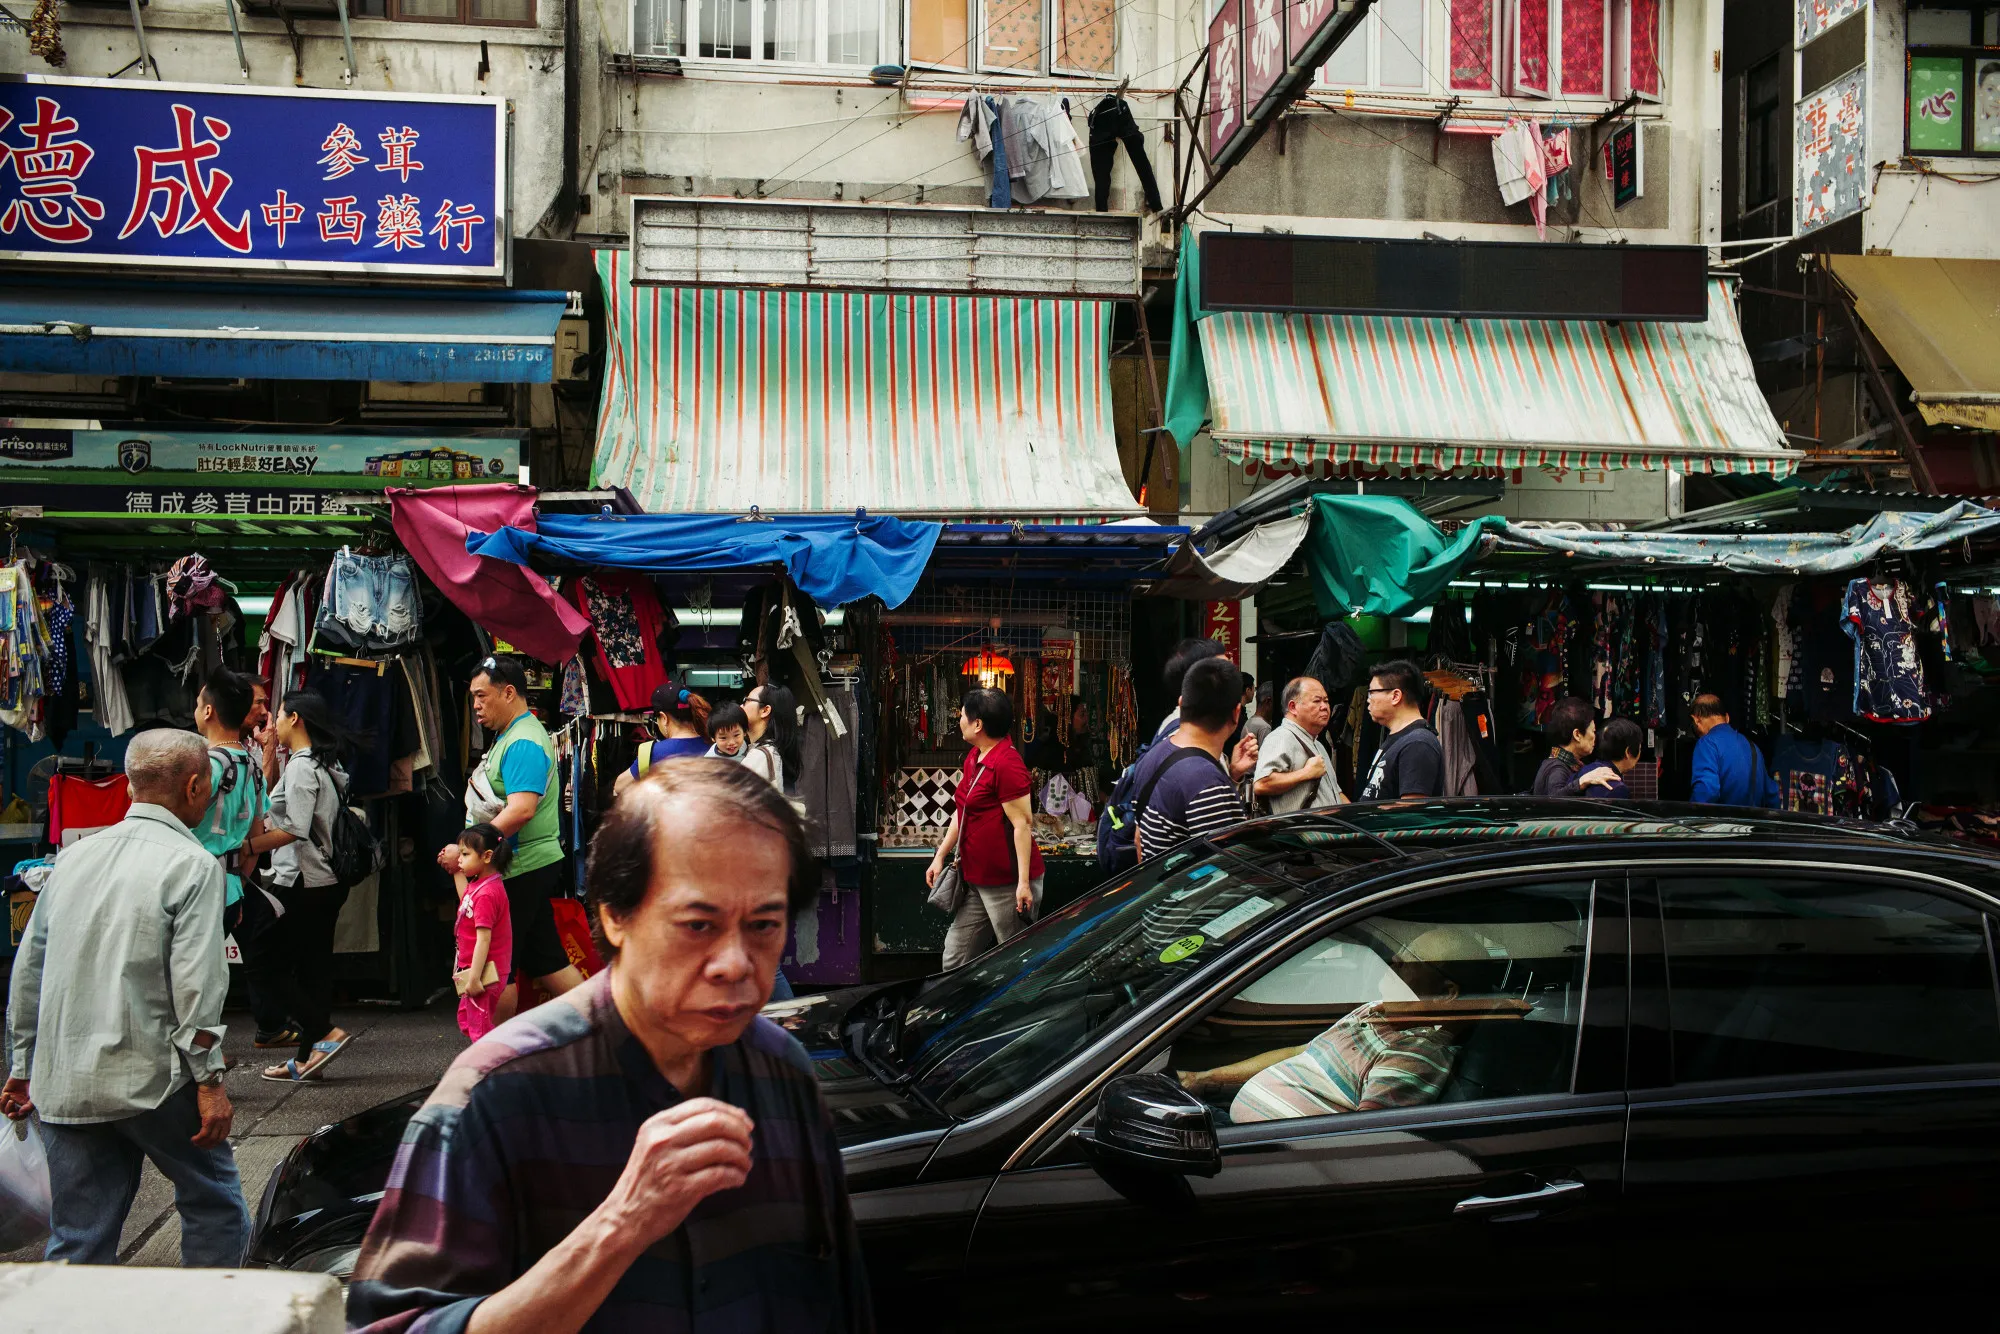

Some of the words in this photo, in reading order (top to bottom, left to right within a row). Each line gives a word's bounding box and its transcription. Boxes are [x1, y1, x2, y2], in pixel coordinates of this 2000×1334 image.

[317, 122, 424, 183] 參茸
[0, 96, 253, 253] 德成
[260, 189, 486, 254] 中西藥行
[0, 436, 35, 450] Friso
[225, 945, 239, 959] 13
[1178, 937, 1199, 952] 2017
